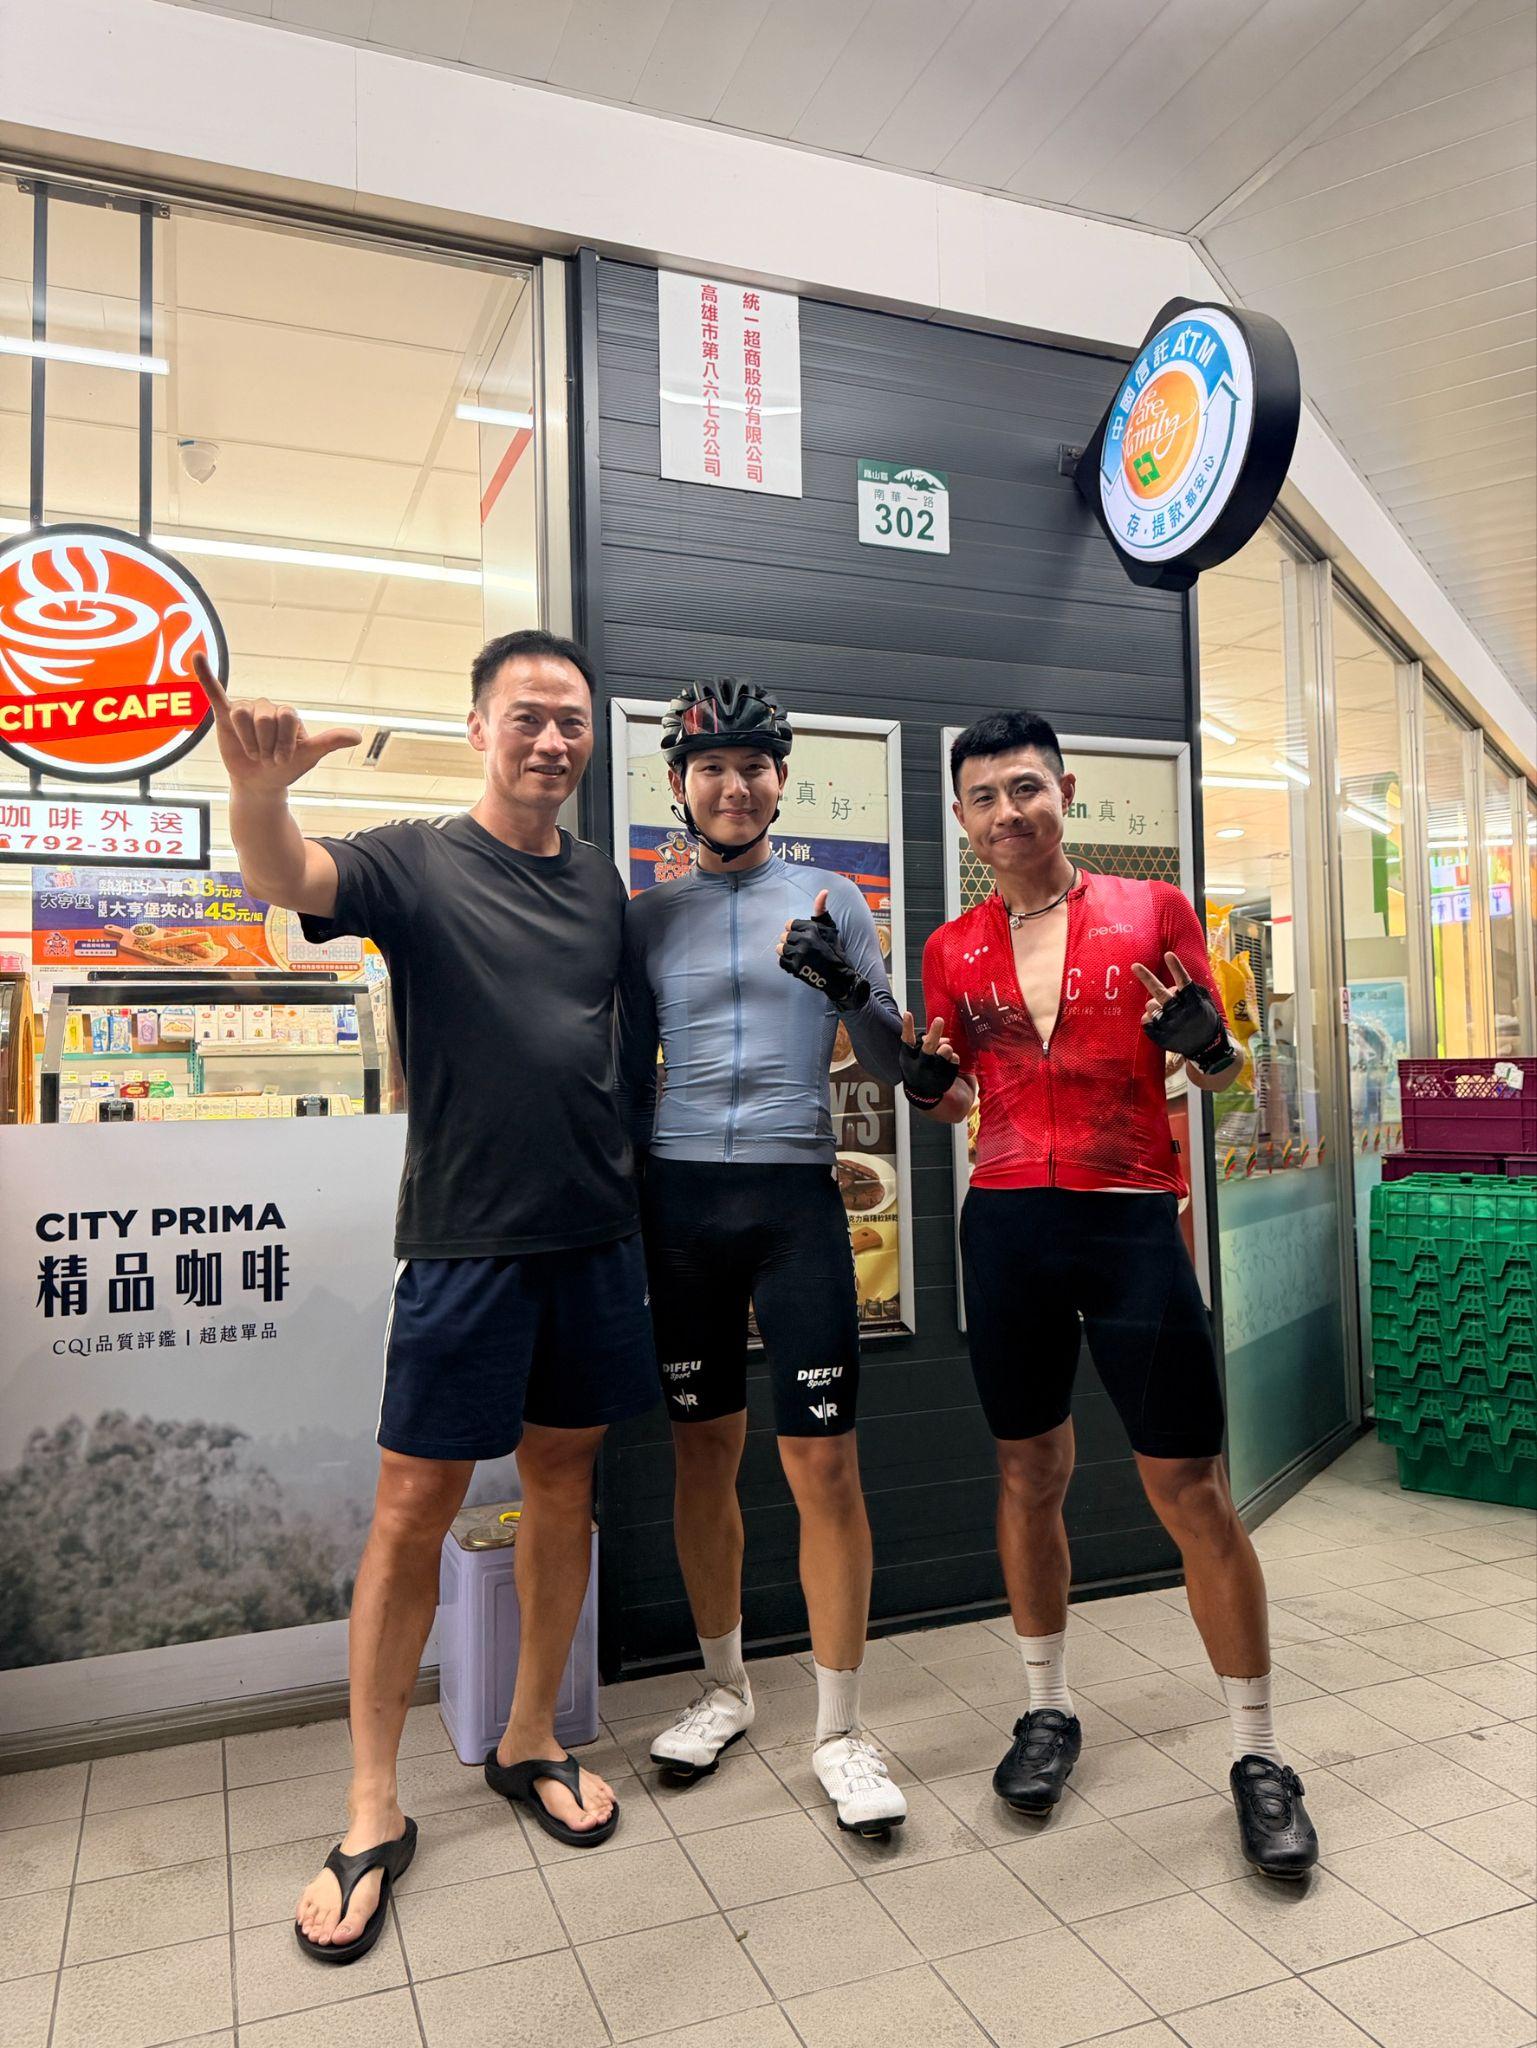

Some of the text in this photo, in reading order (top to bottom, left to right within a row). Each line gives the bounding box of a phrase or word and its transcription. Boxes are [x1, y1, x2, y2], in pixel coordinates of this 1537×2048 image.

[700, 284, 721, 478] 高雄市第八六七分公司
[742, 292, 763, 484] 統一超商股份有限公司
[874, 488, 934, 508] 南華一路
[875, 503, 935, 541] 302
[0, 691, 192, 731] CITY CAFE
[0, 805, 183, 834] 咖啡外送
[21, 833, 183, 855] 792-3302
[769, 842, 811, 862] 小館
[41, 892, 91, 909] 大亨堡
[1088, 922, 1134, 940] pedla
[799, 964, 827, 989] POC
[35, 1202, 287, 1242] CITY PRIMA
[35, 1244, 290, 1318] 精品咖啡
[52, 1330, 177, 1357] CQI品質評鑑
[199, 1322, 278, 1345] 超越單品
[662, 1360, 702, 1373] DIFFU
[670, 1370, 692, 1381] Sport
[797, 1366, 843, 1381] DIFFU
[807, 1377, 832, 1389] Sport
